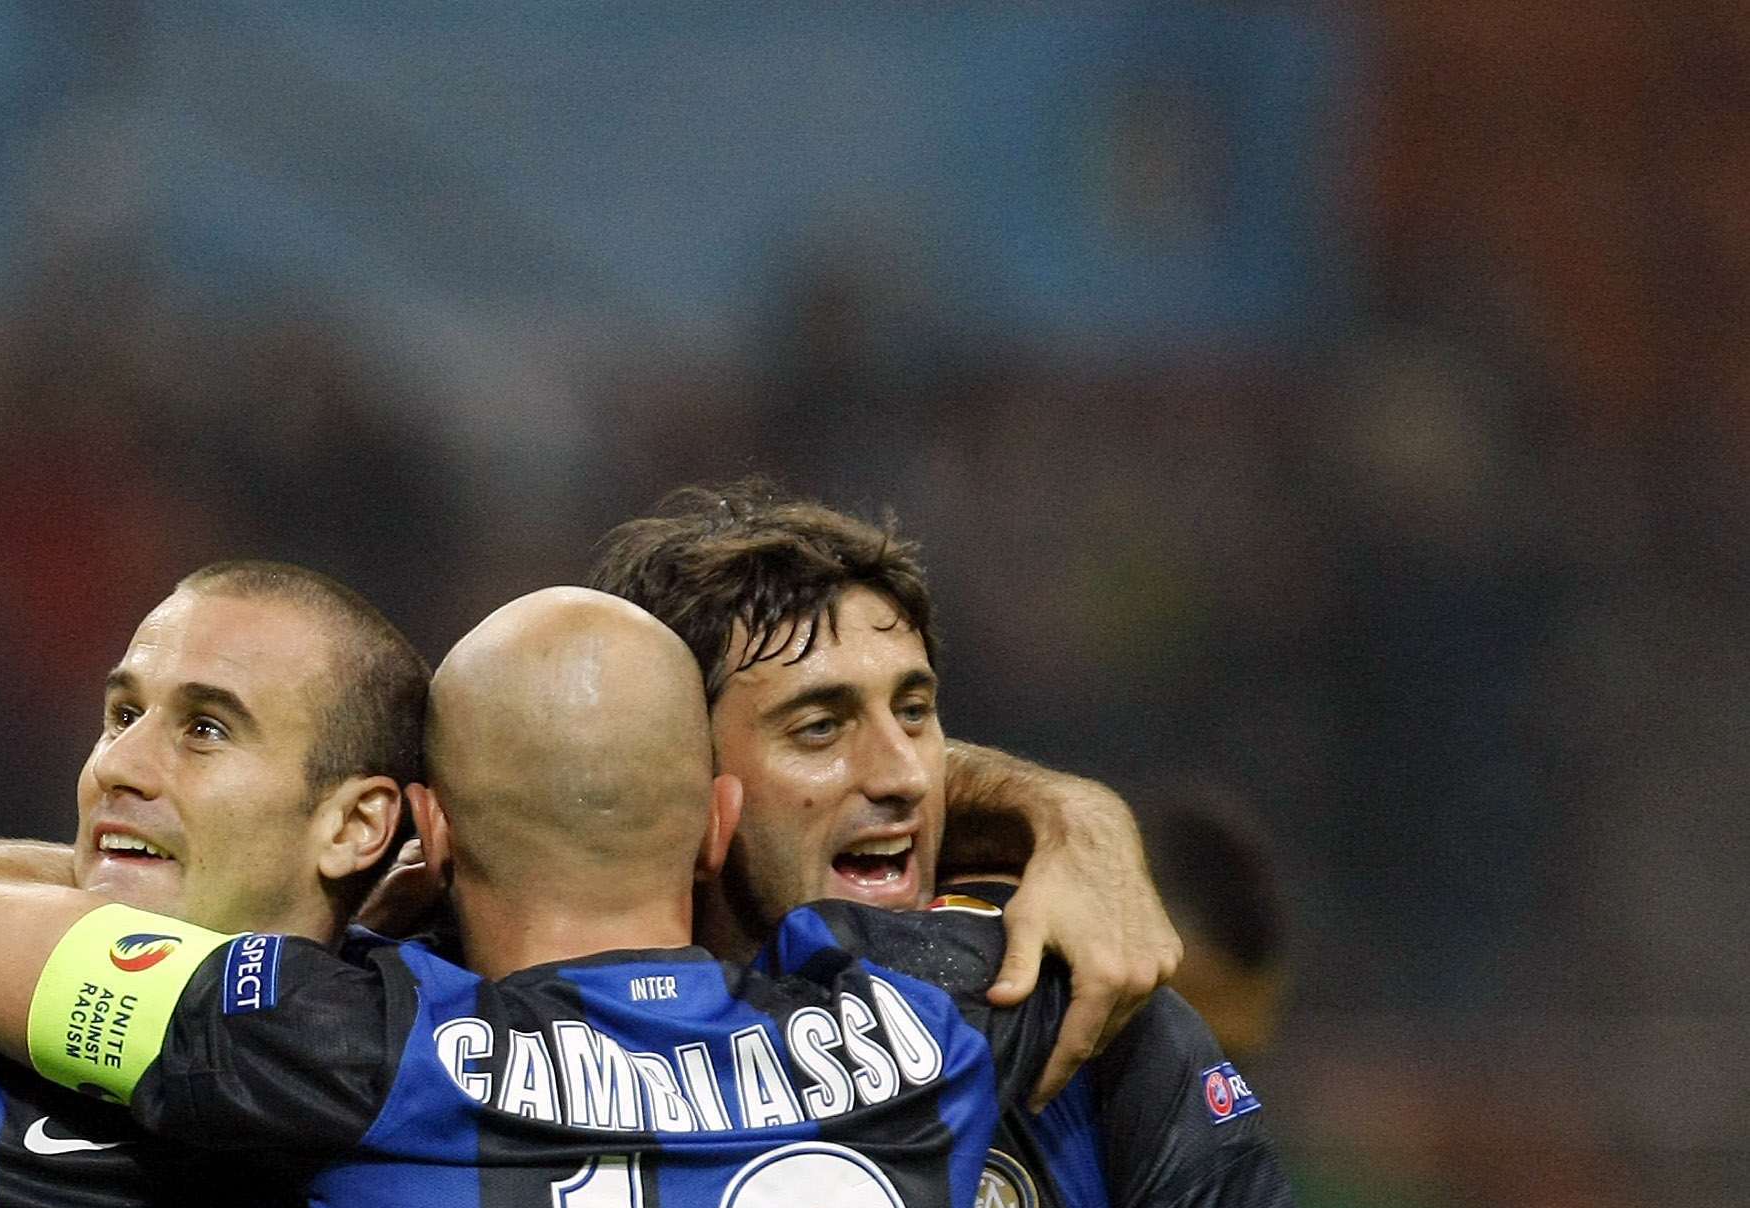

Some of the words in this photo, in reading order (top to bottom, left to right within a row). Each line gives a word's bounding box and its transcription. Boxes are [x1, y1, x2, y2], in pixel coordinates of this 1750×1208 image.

[237, 932, 266, 1009] SPECT
[631, 976, 678, 1001] INTER
[65, 982, 98, 1059] RACISM
[84, 987, 115, 1065] AGAINST
[105, 994, 138, 1069] UNITE
[433, 975, 944, 1134] CAMBIASSO
